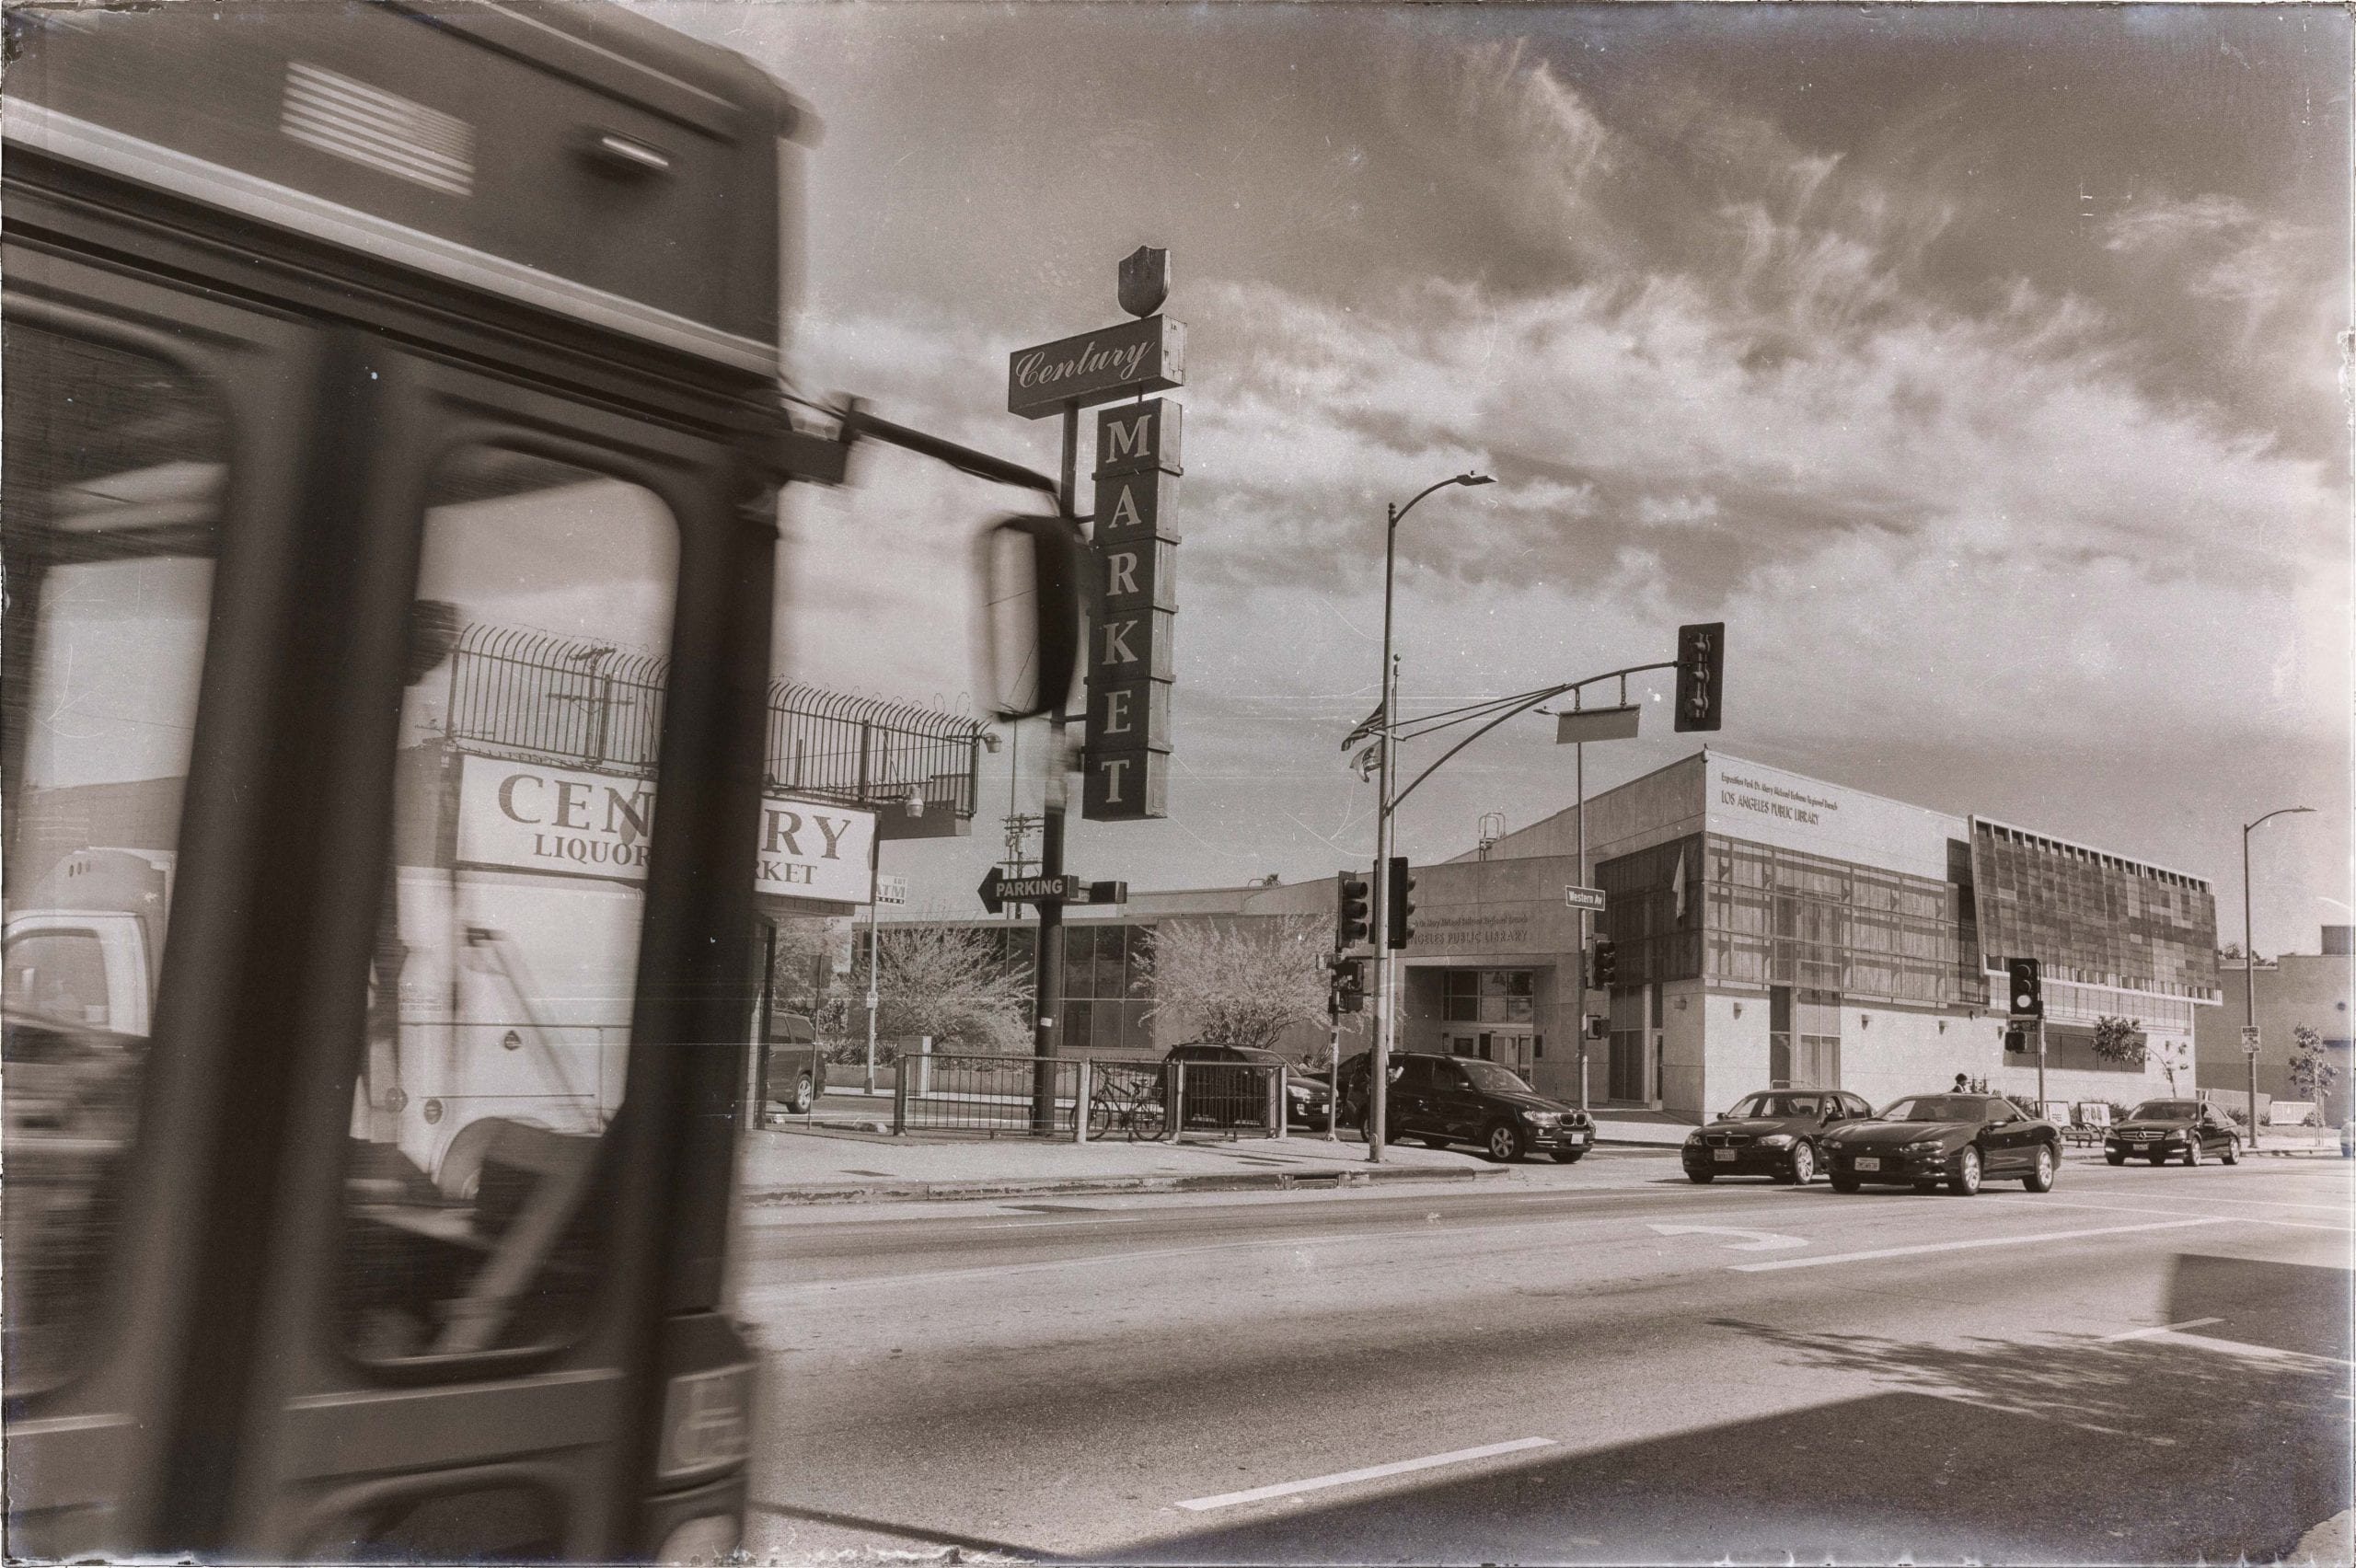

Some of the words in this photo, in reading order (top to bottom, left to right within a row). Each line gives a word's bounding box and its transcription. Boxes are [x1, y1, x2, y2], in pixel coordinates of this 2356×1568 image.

[1016, 340, 1155, 388] Century
[1100, 413, 1152, 803] MARKET
[498, 773, 851, 861] CENRY
[1721, 790, 1736, 805] LOS
[1738, 794, 1770, 813] ANGELES
[1771, 802, 1793, 820] PUBLIC
[1794, 808, 1819, 825] LIBRARY
[996, 879, 1063, 897] PARKING
[1568, 890, 1594, 904] Western
[1594, 894, 1602, 905] Av
[1408, 932, 1445, 945] NGELES
[1448, 930, 1482, 944] PUBLIC
[1484, 928, 1528, 943] LIBRARY
